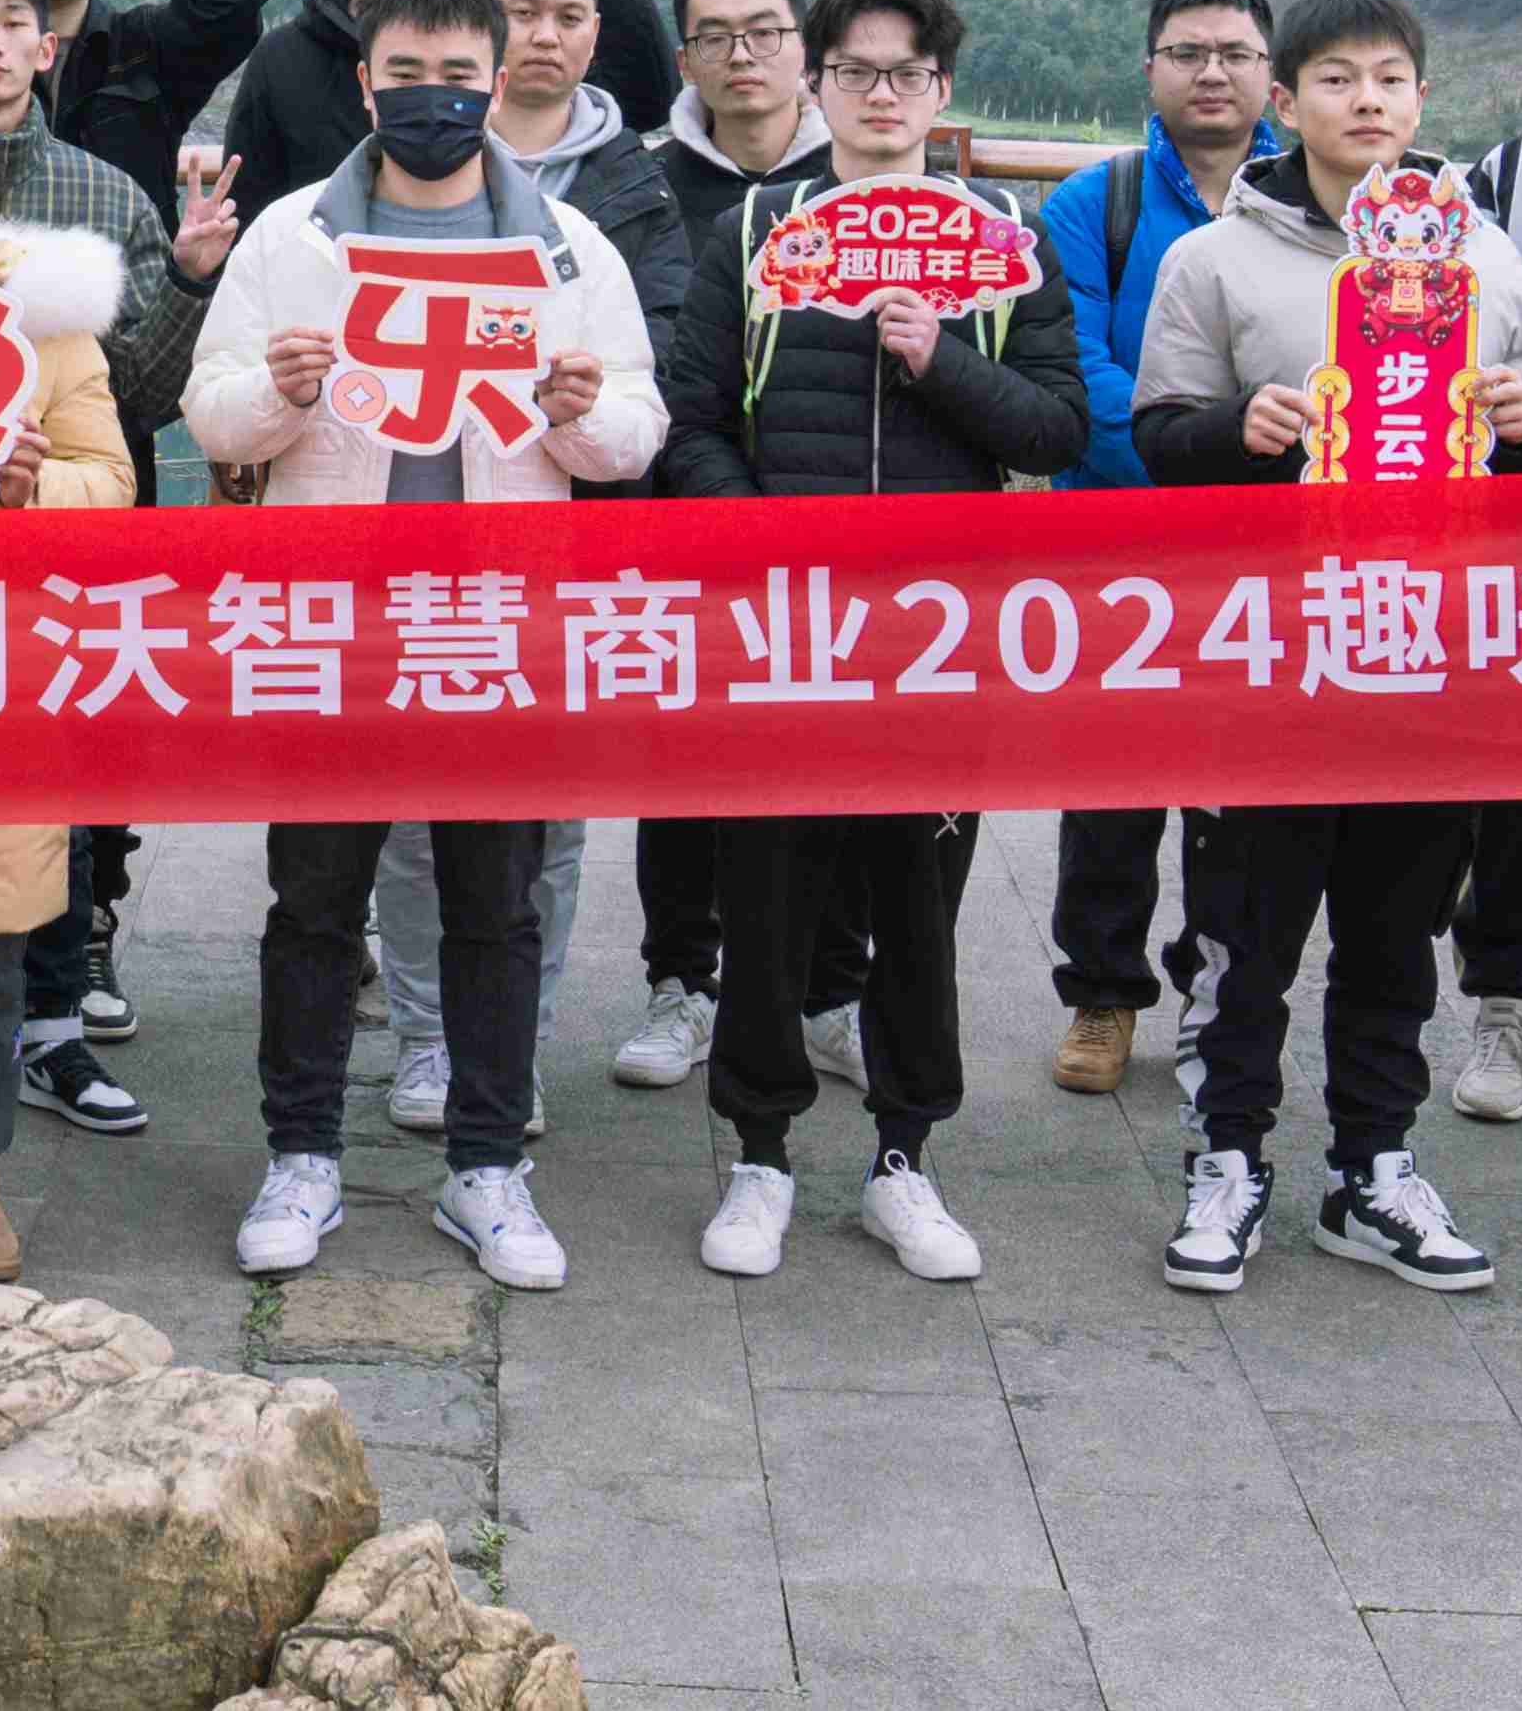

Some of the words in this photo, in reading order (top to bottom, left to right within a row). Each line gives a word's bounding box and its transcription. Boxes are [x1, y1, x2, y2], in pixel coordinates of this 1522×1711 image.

[835, 203, 975, 241] 2024
[835, 246, 1009, 282] 趣味年会
[342, 246, 549, 448] 乐
[1373, 350, 1430, 482] 步云
